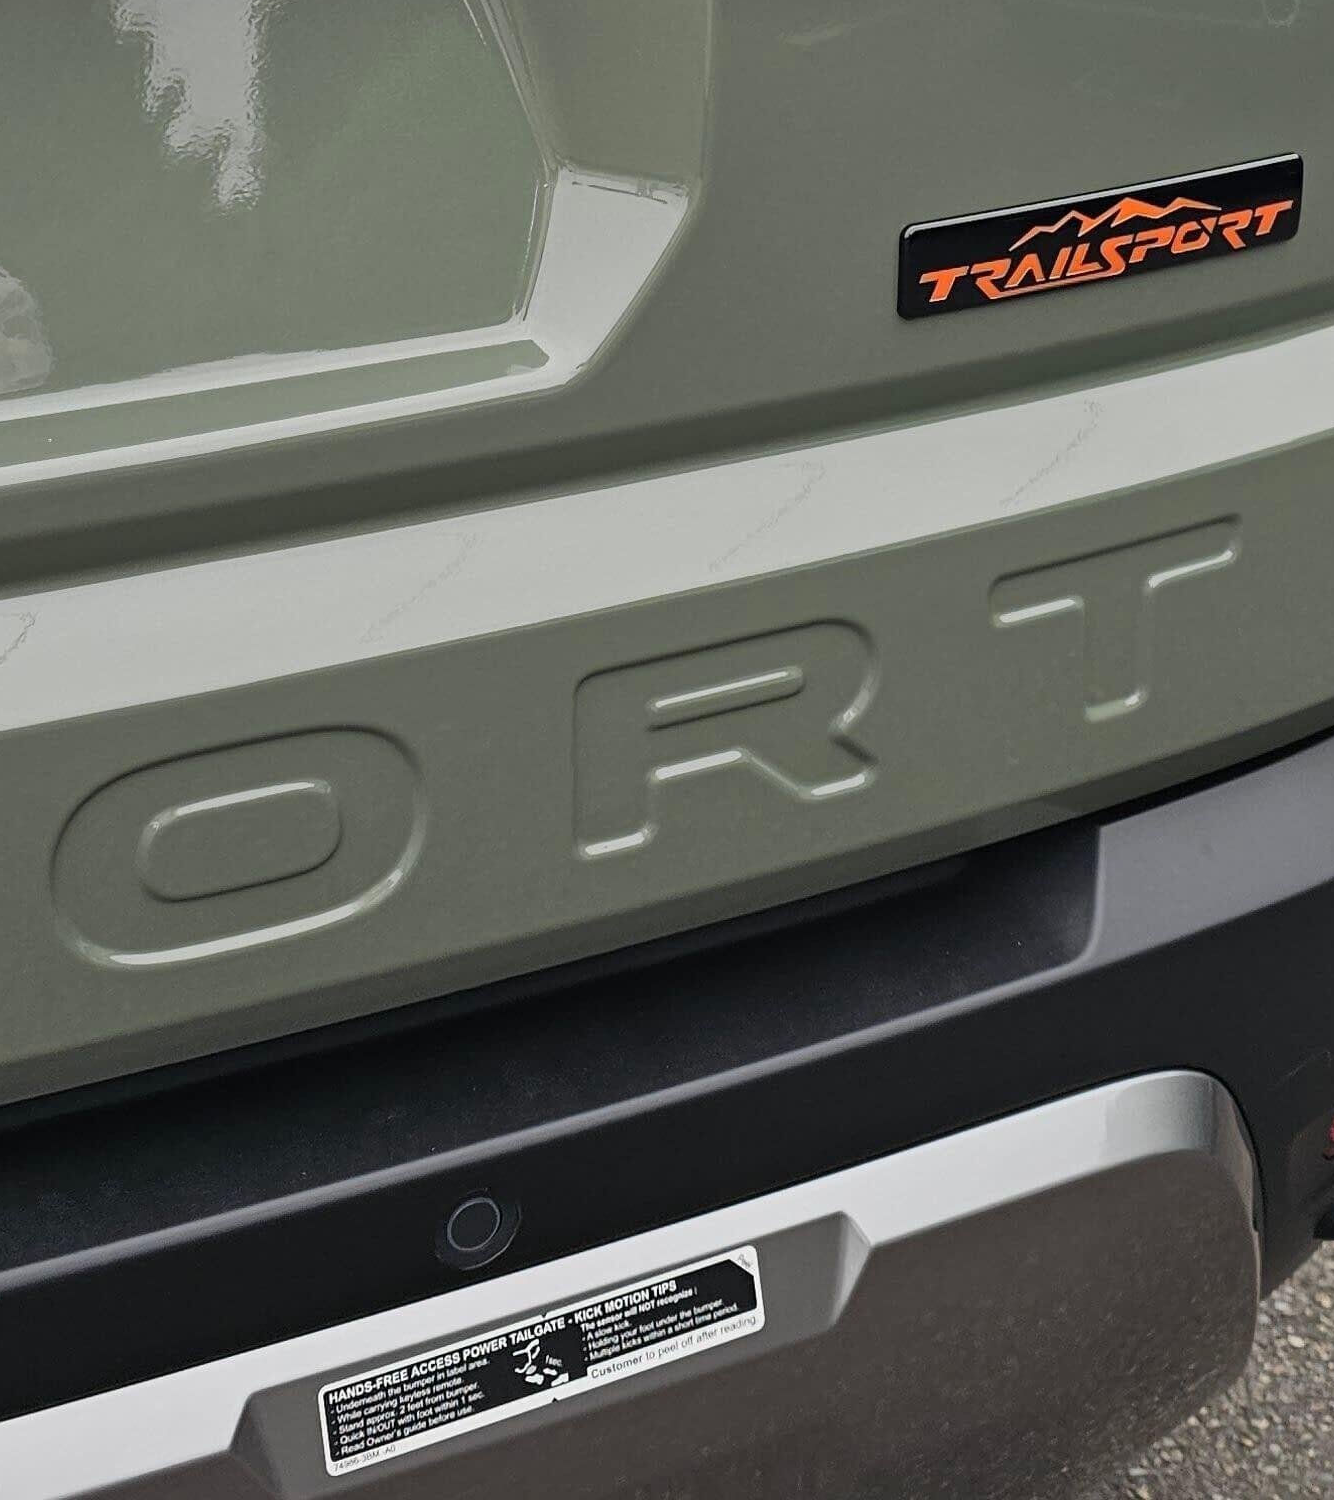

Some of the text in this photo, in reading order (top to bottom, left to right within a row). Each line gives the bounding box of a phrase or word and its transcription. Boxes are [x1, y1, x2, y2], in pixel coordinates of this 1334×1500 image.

[918, 199, 1295, 304] TRAILSPORT
[587, 1333, 618, 1352] Holding
[620, 1328, 637, 1342] your
[638, 1320, 654, 1333] foot
[655, 1313, 677, 1328] under
[679, 1308, 692, 1320] the
[638, 1300, 655, 1313] NOT
[643, 1327, 666, 1342] within
[673, 1318, 693, 1332] short
[328, 1279, 677, 1405] HANDS-FREE ACCESS POWER TAILGATE KICK MOTION TIPS
[590, 1353, 642, 1379] Customer
[679, 1335, 694, 1348] off
[696, 1327, 717, 1343] after
[335, 1389, 386, 1414] Underneath
[387, 1384, 401, 1397] the
[403, 1373, 435, 1392] bumper
[446, 1362, 466, 1377] label
[337, 1409, 362, 1425] While
[363, 1397, 397, 1418] carrying
[399, 1386, 430, 1405] keyless
[338, 1419, 364, 1435] Stand
[406, 1399, 424, 1412] feet
[424, 1392, 444, 1406] from
[339, 1429, 364, 1446] Quick
[397, 1412, 415, 1426] with
[416, 1406, 433, 1419] foot
[433, 1397, 458, 1413] within
[340, 1439, 364, 1456] Read
[403, 1419, 427, 1436] guide
[427, 1409, 455, 1426] before
